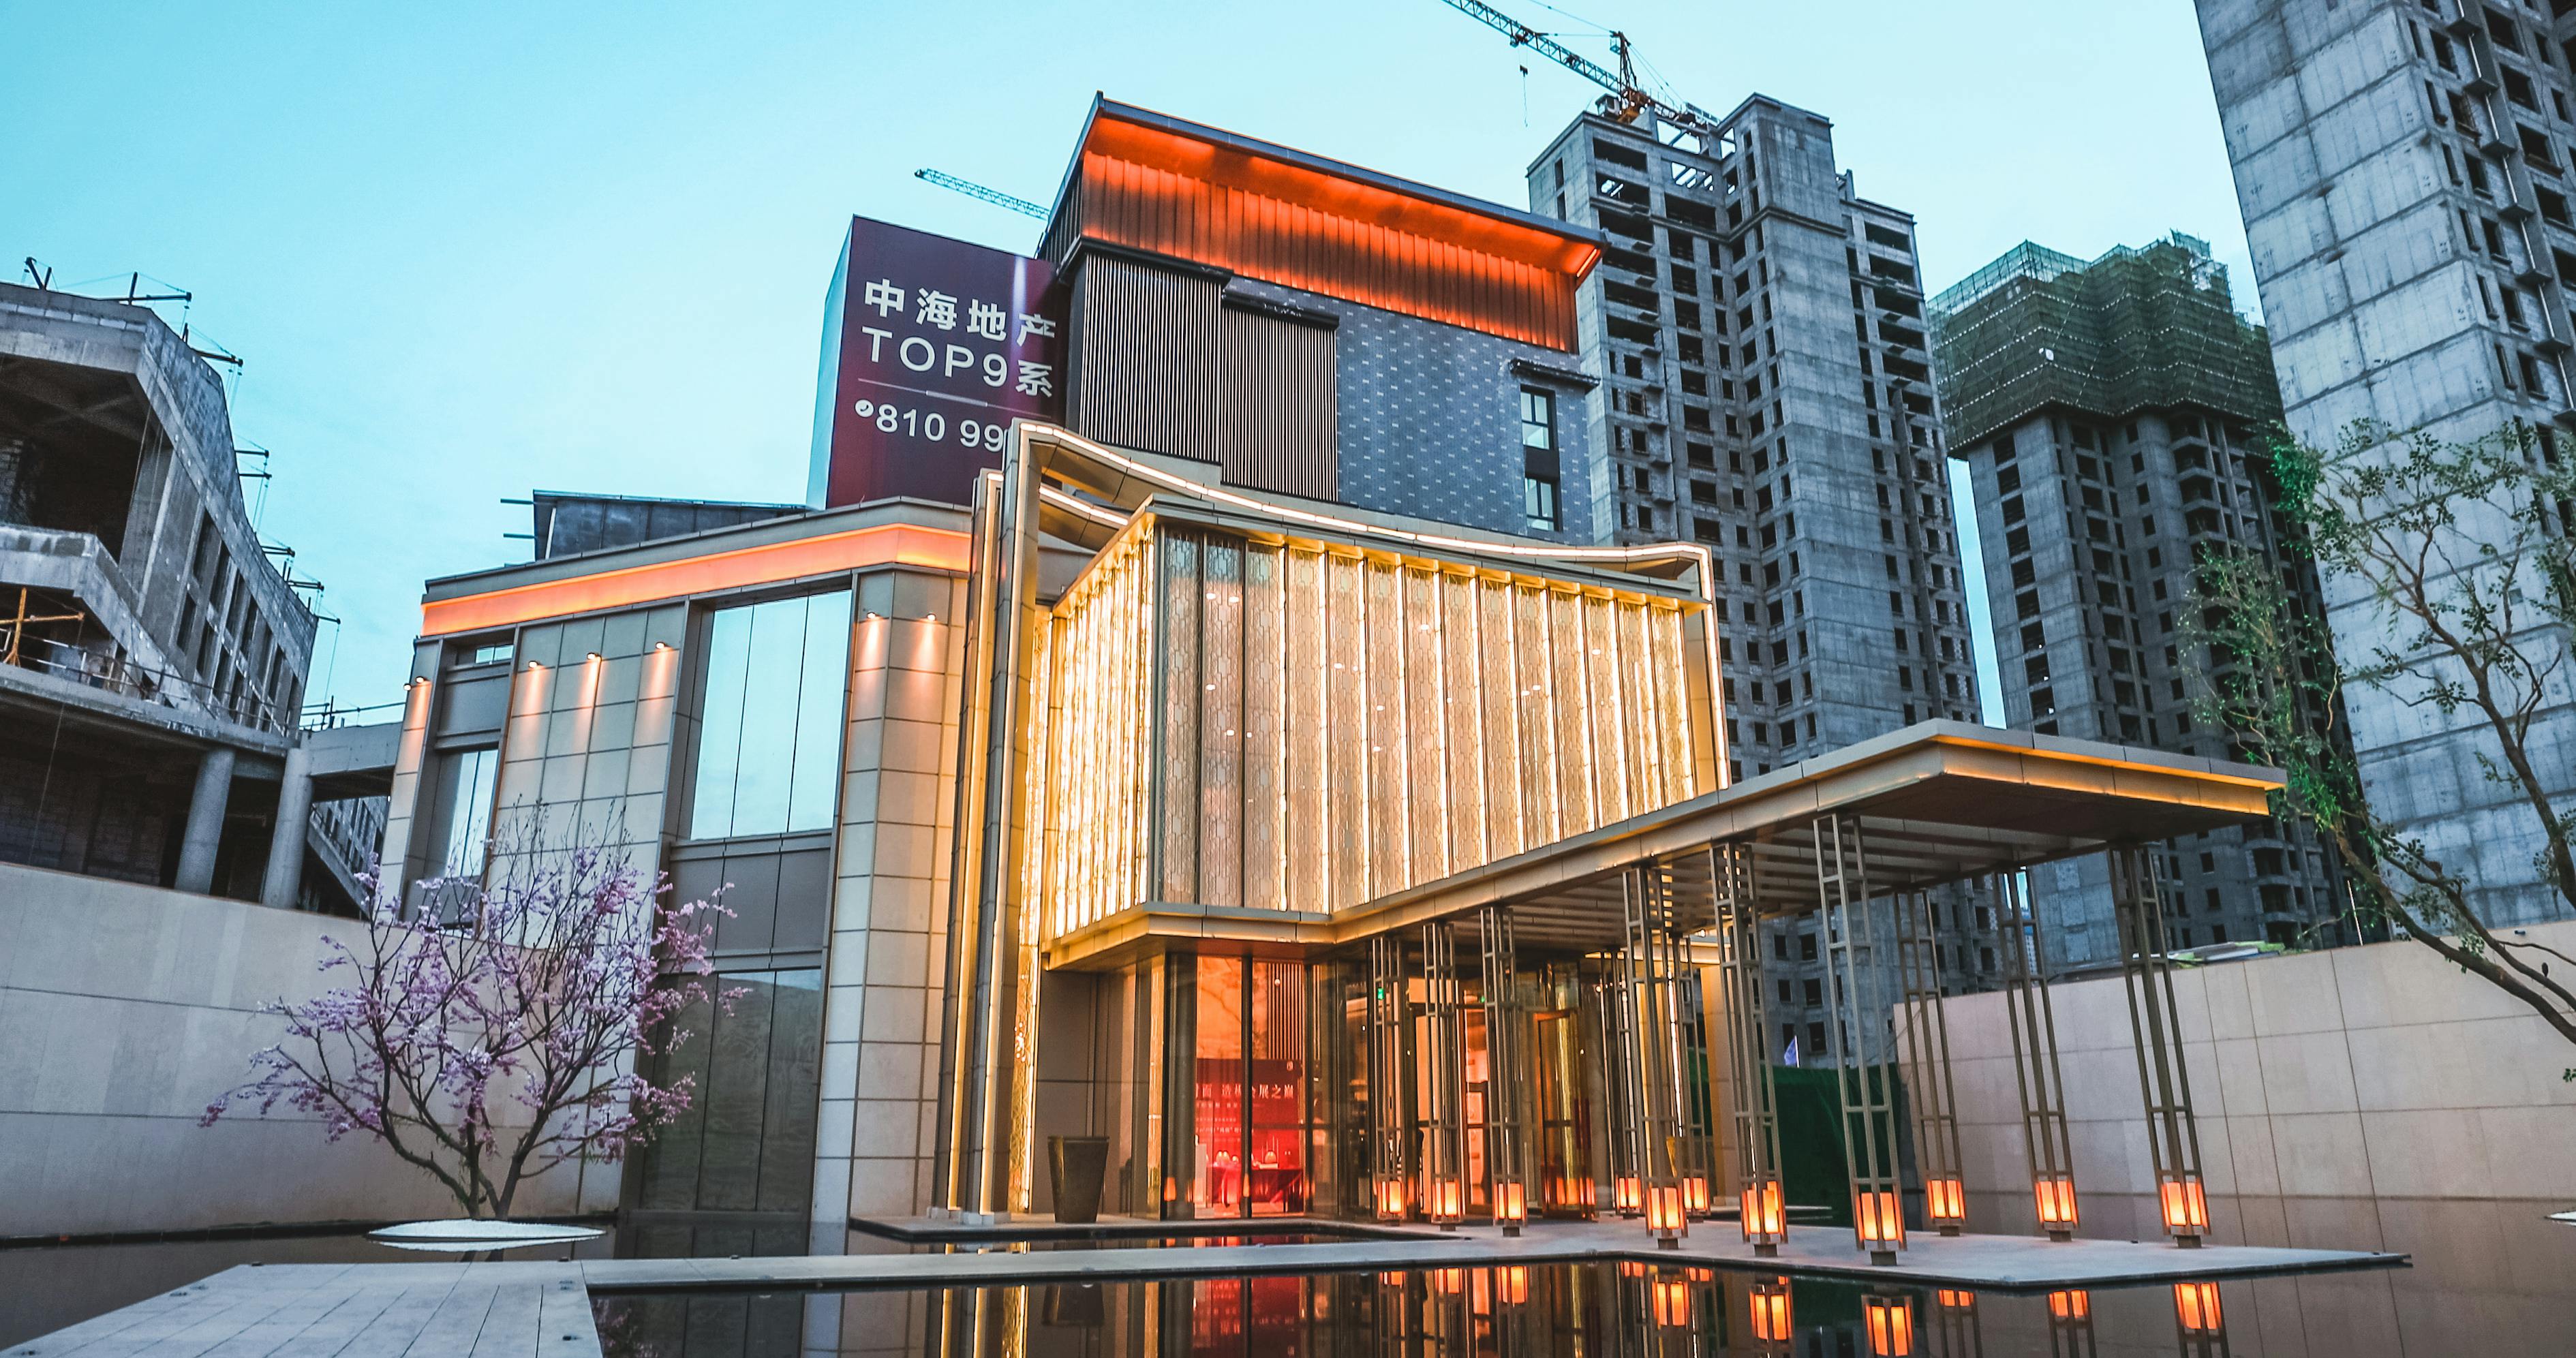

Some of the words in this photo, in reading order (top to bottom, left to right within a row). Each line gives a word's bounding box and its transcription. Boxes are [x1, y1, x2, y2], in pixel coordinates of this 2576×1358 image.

[864, 279, 1056, 347] 中海地产
[861, 326, 1053, 397] TOP9系
[876, 403, 946, 442] 810
[960, 420, 1004, 452] 99
